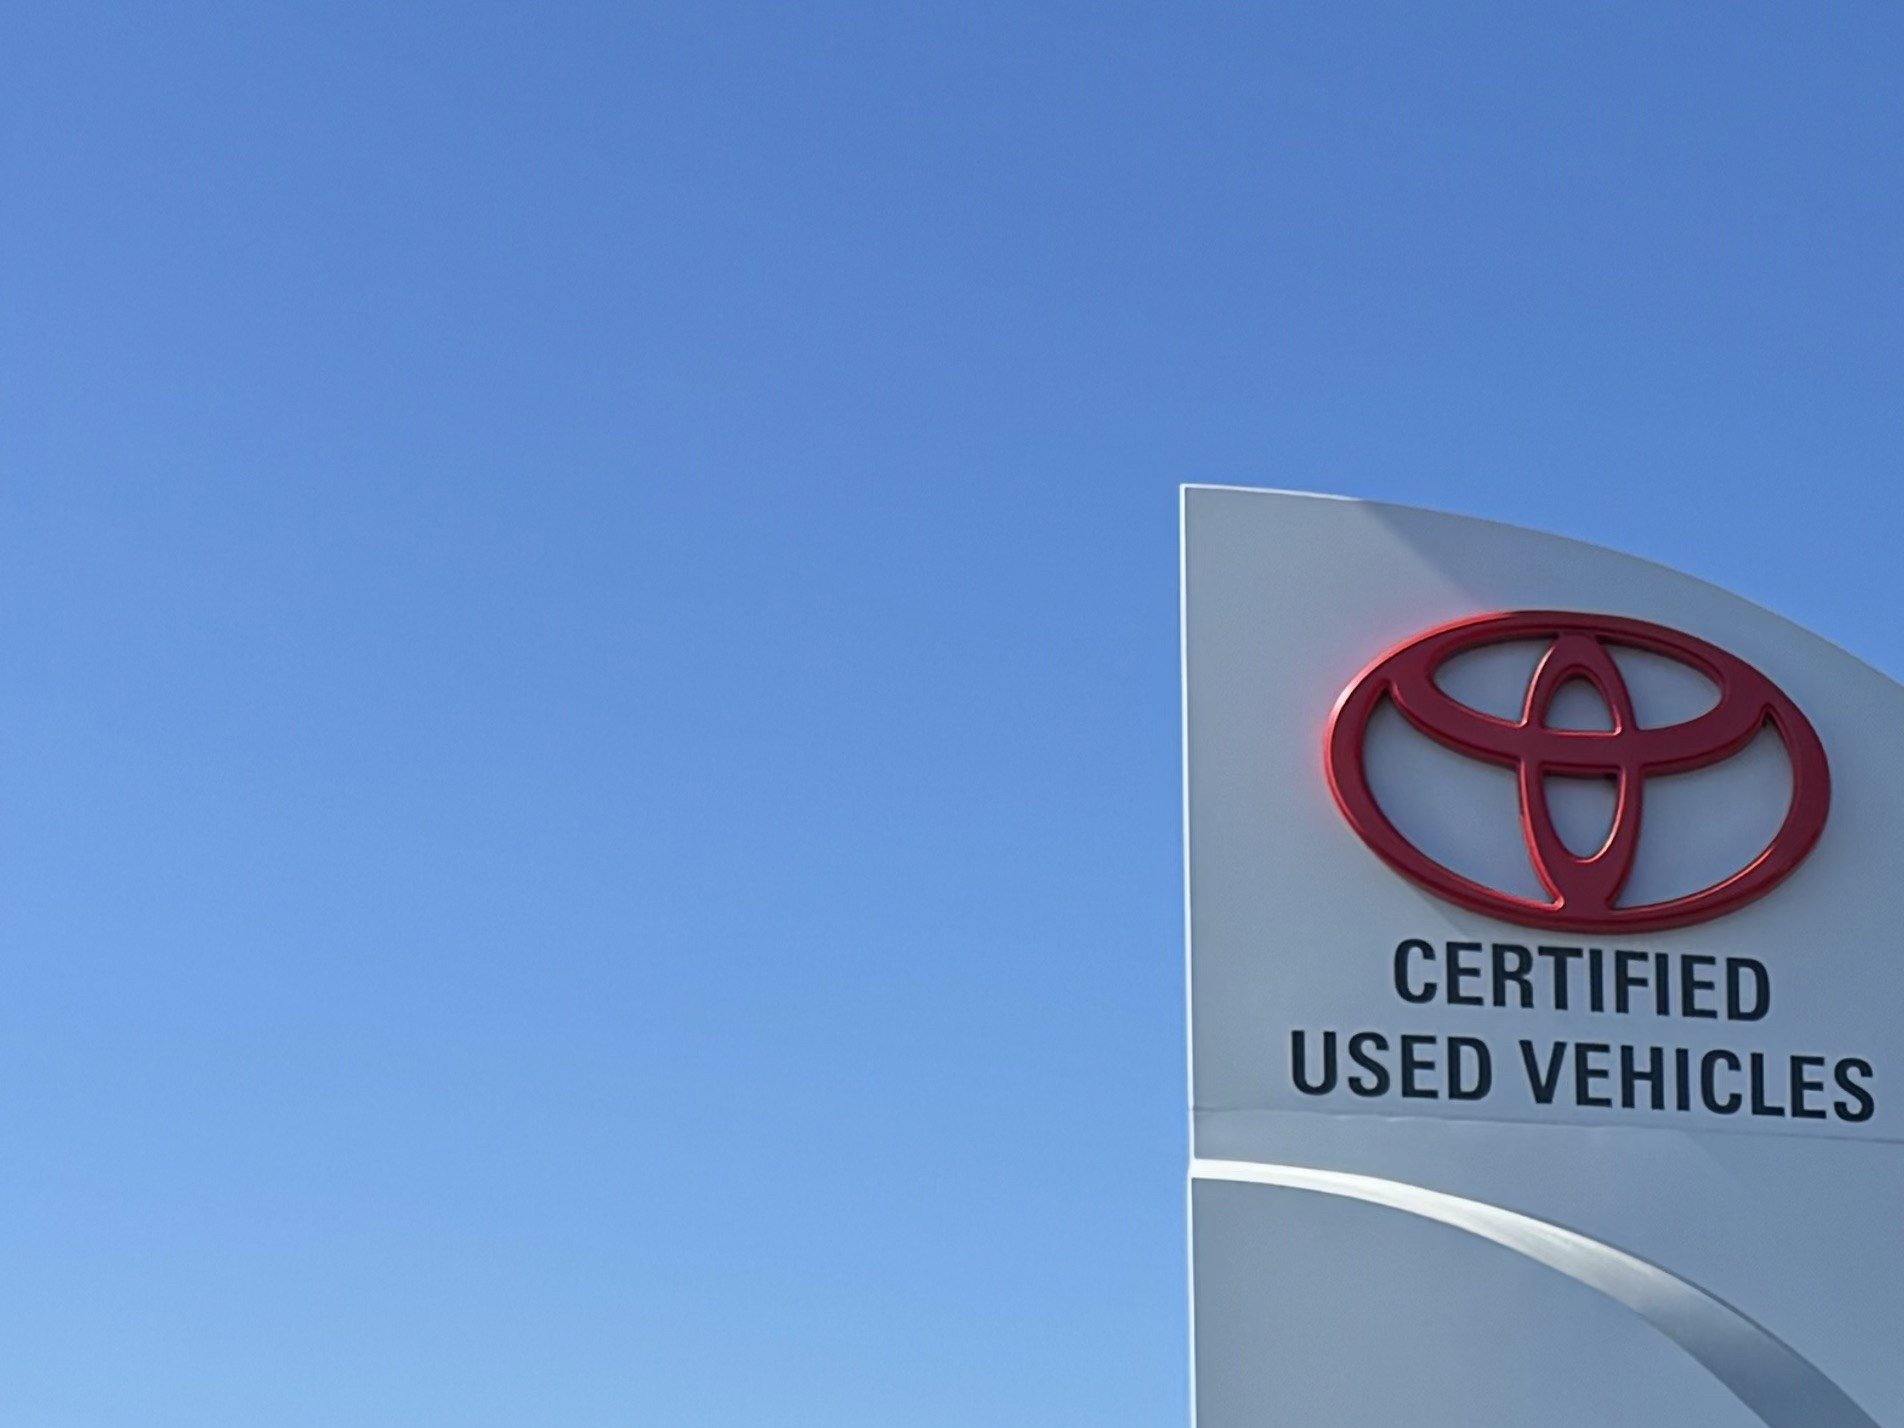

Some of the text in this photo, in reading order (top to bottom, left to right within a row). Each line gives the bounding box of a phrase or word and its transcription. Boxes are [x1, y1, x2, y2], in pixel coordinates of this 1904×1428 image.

[1392, 938, 1771, 1023] CERTIFIED
[1291, 1030, 1875, 1123] USED VEHICLES
